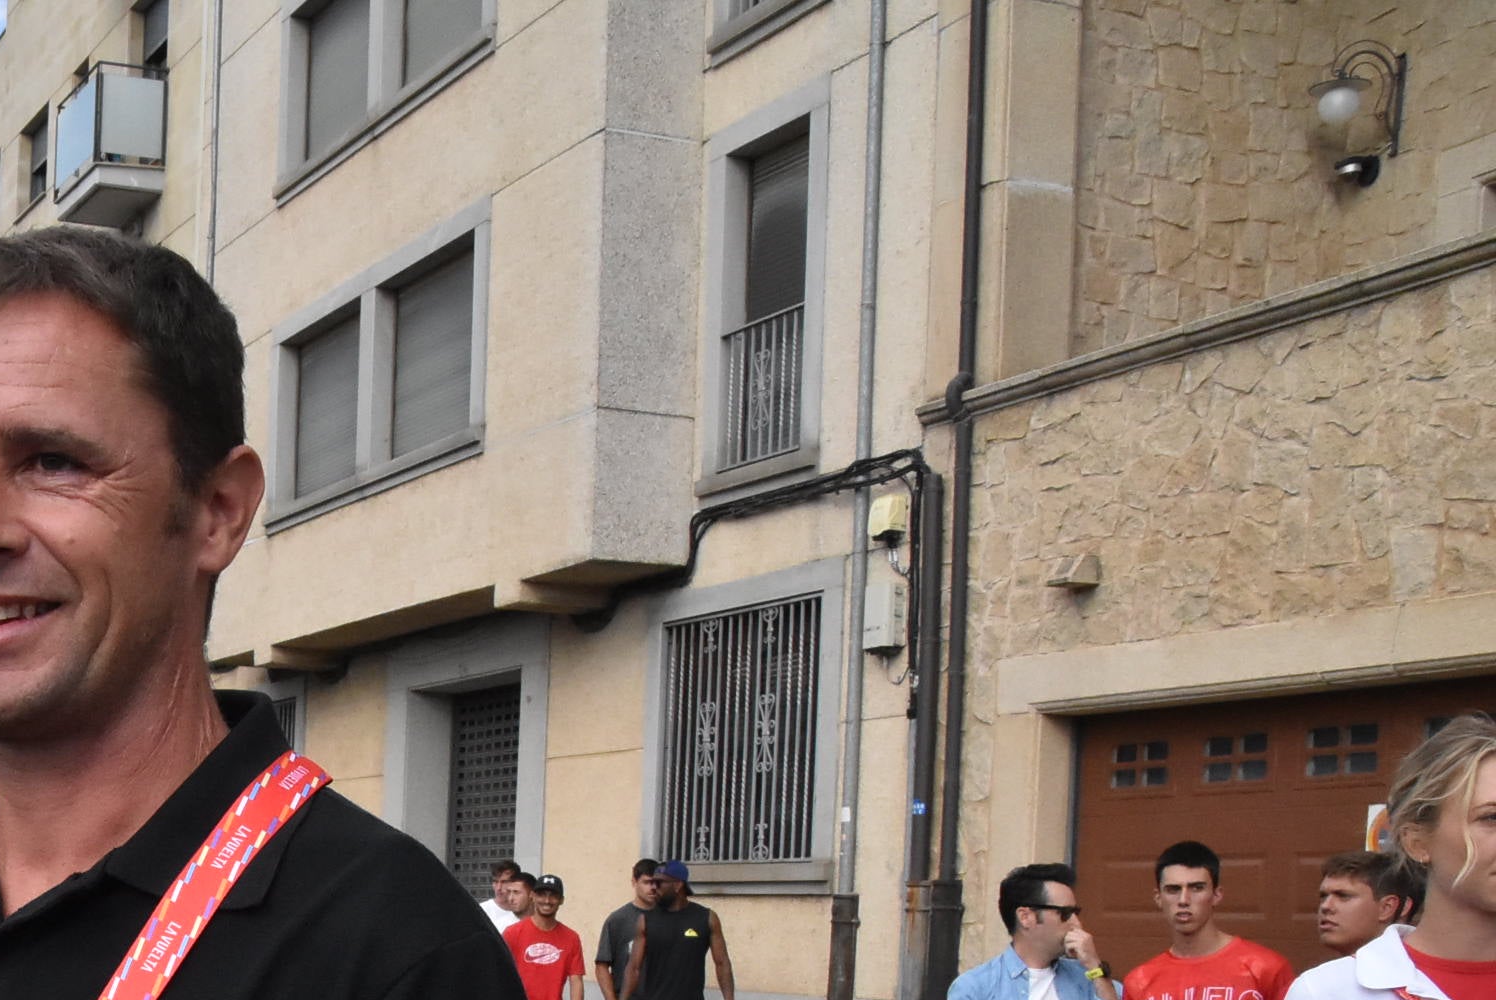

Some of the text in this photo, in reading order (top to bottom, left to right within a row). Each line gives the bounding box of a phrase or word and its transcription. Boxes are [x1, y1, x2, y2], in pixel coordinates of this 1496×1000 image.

[210, 824, 252, 869] LA VUELTA
[140, 921, 182, 972] LA VUELTA
